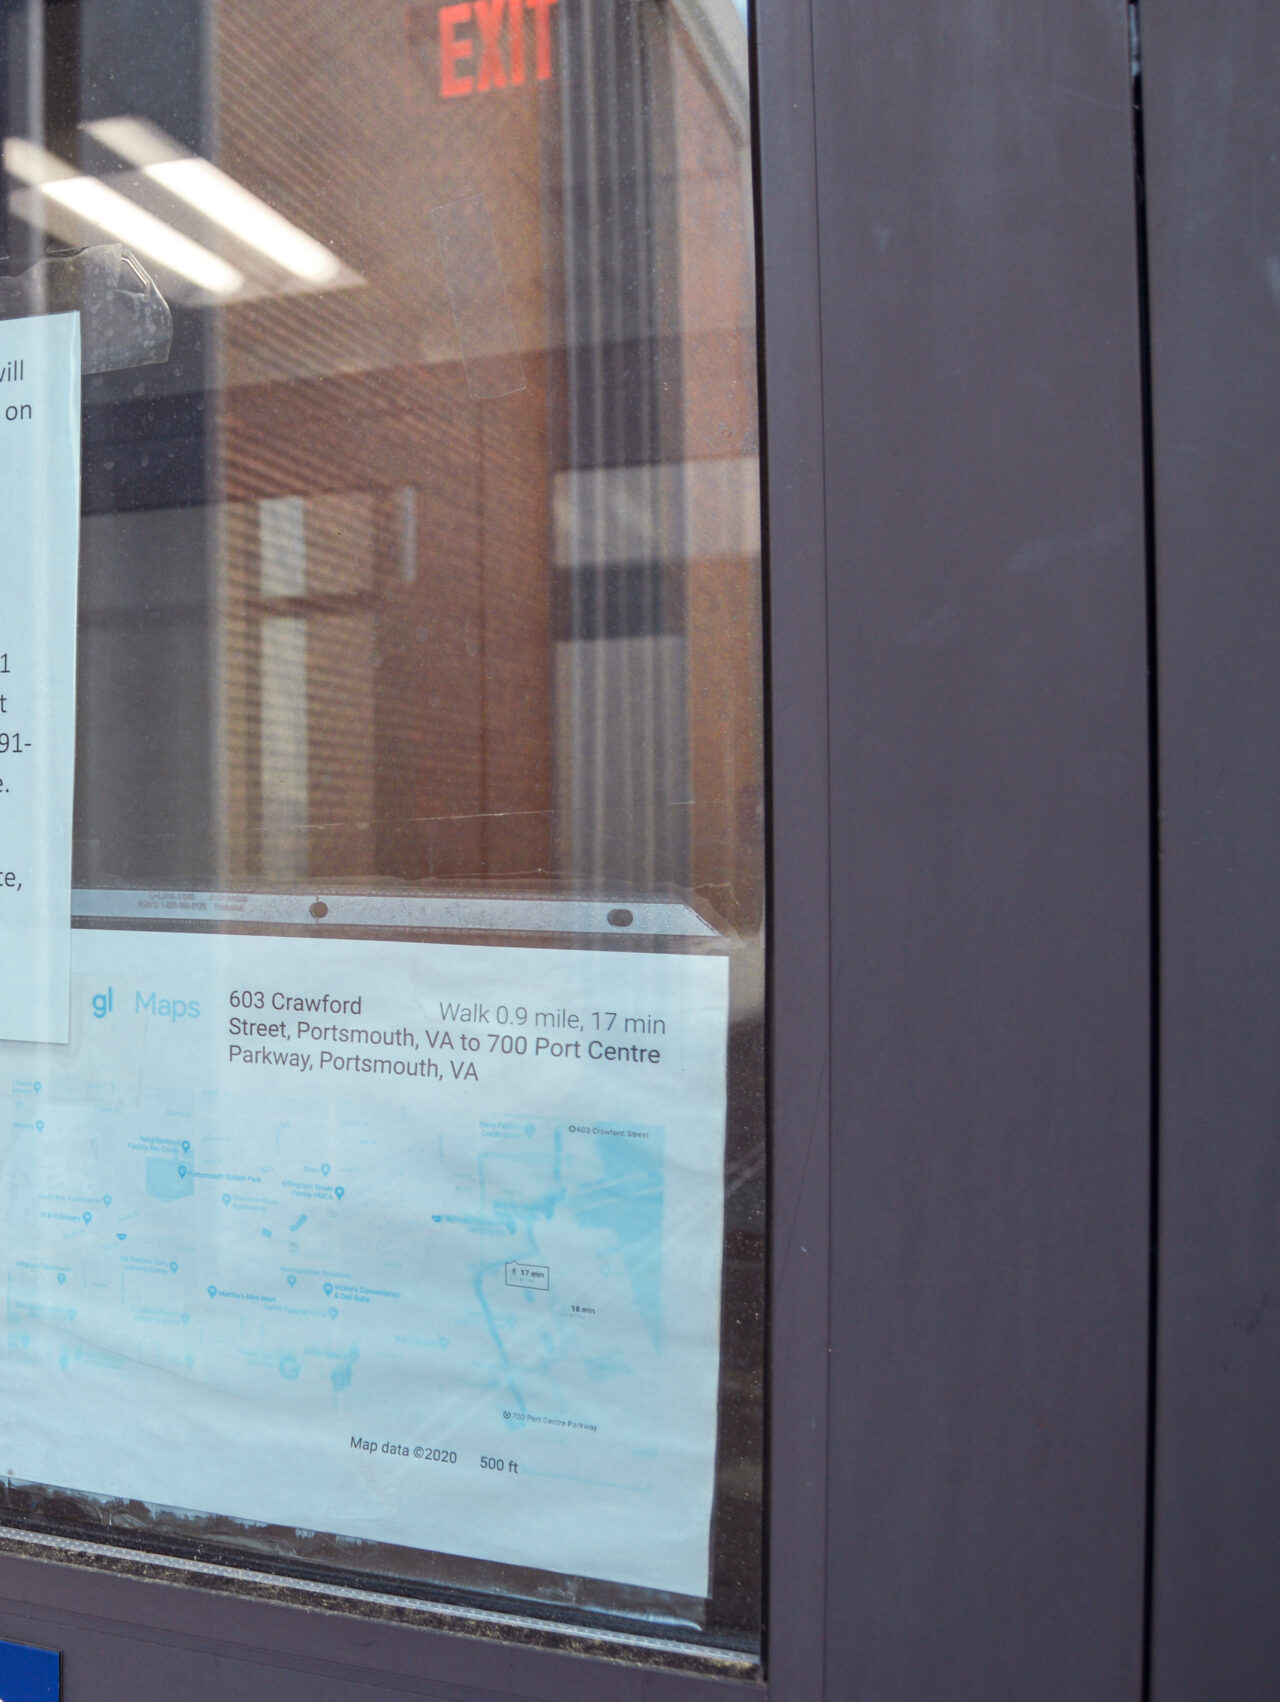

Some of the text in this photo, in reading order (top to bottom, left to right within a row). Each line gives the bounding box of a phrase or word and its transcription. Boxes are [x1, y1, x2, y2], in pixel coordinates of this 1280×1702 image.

[439, 0, 560, 98] EXIT
[6, 404, 32, 421] on
[135, 990, 201, 1023] Maps
[230, 991, 361, 1015] 603 Crawford
[440, 1002, 665, 1034] Walk 0.9 mile, 17 min
[229, 1017, 660, 1063] Street, Portsmouth, VA to 700 Port Centre
[230, 1045, 479, 1081] Parkway, Portsmouth, VA
[627, 1130, 649, 1138] Street
[521, 1269, 545, 1279] 17 min
[581, 1306, 596, 1315] min
[526, 1414, 541, 1423] Port
[567, 1420, 598, 1432] Parkway
[350, 1436, 378, 1454] Map
[382, 1441, 409, 1456] data
[480, 1456, 518, 1474] 500 ft
